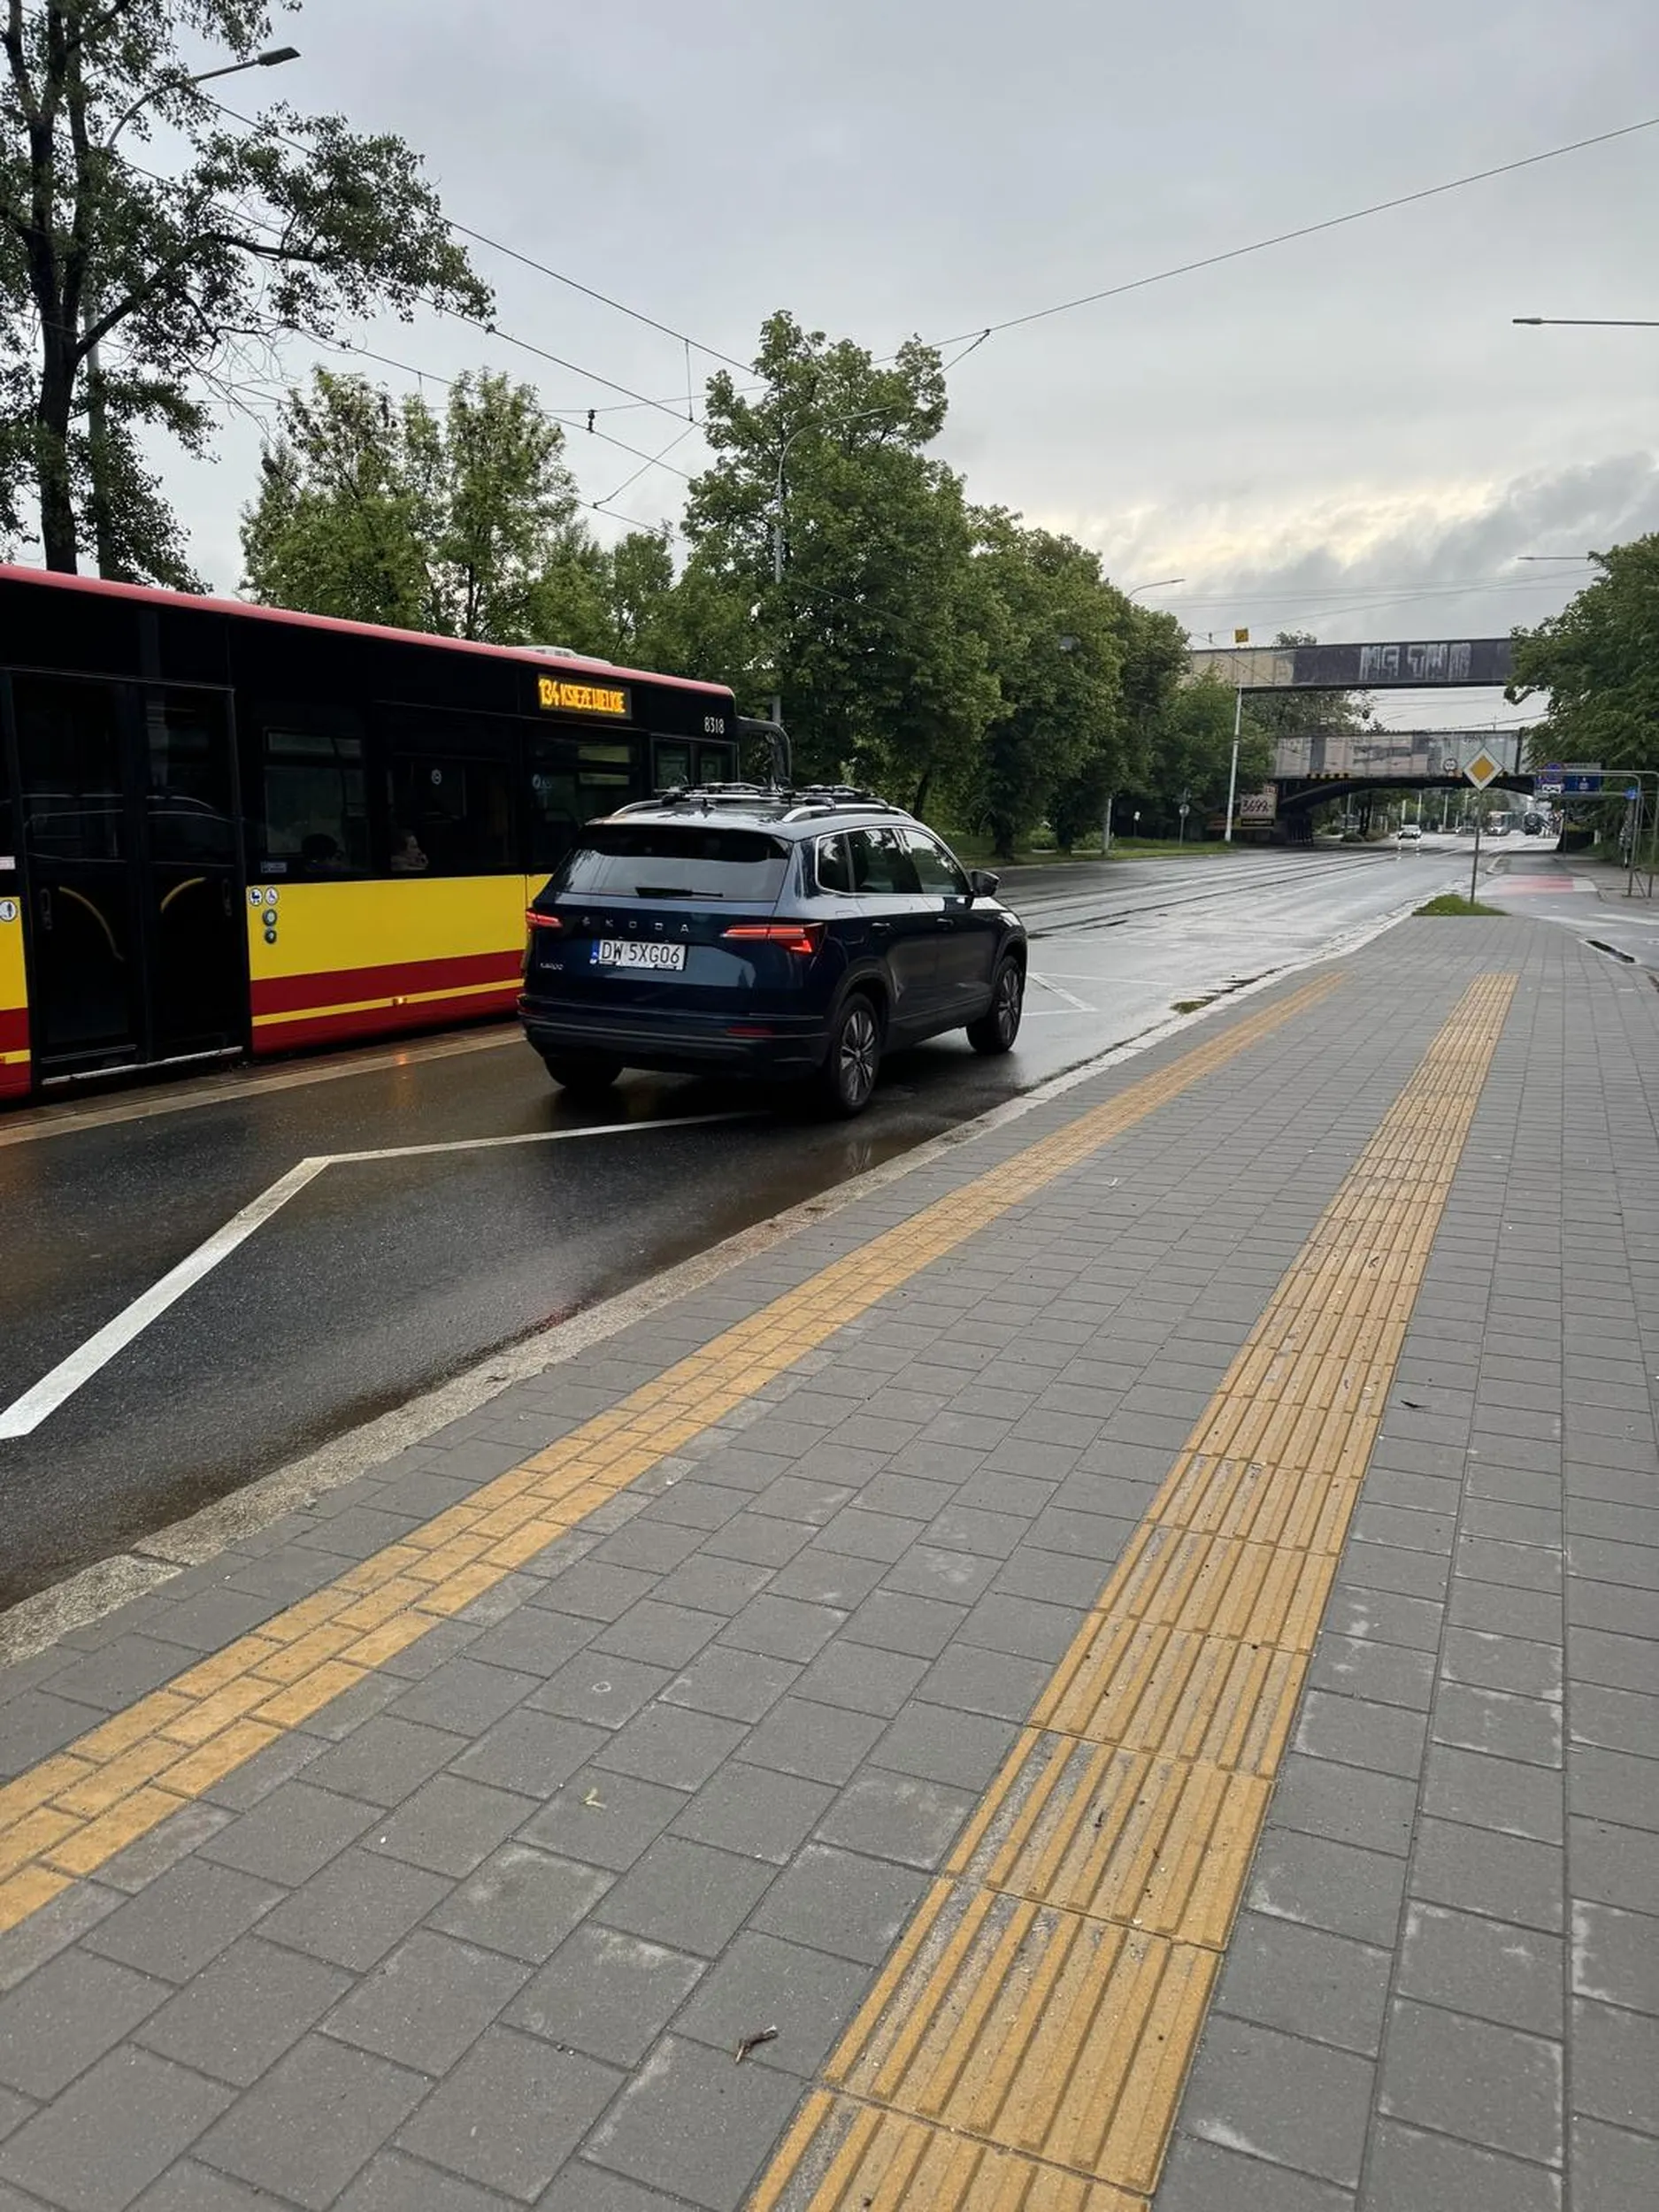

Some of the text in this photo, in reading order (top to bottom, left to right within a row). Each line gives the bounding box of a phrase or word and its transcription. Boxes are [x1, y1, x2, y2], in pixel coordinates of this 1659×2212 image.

[539, 678, 559, 706] 134
[703, 716, 726, 734] 8318
[602, 941, 680, 964] DW 5XG06
